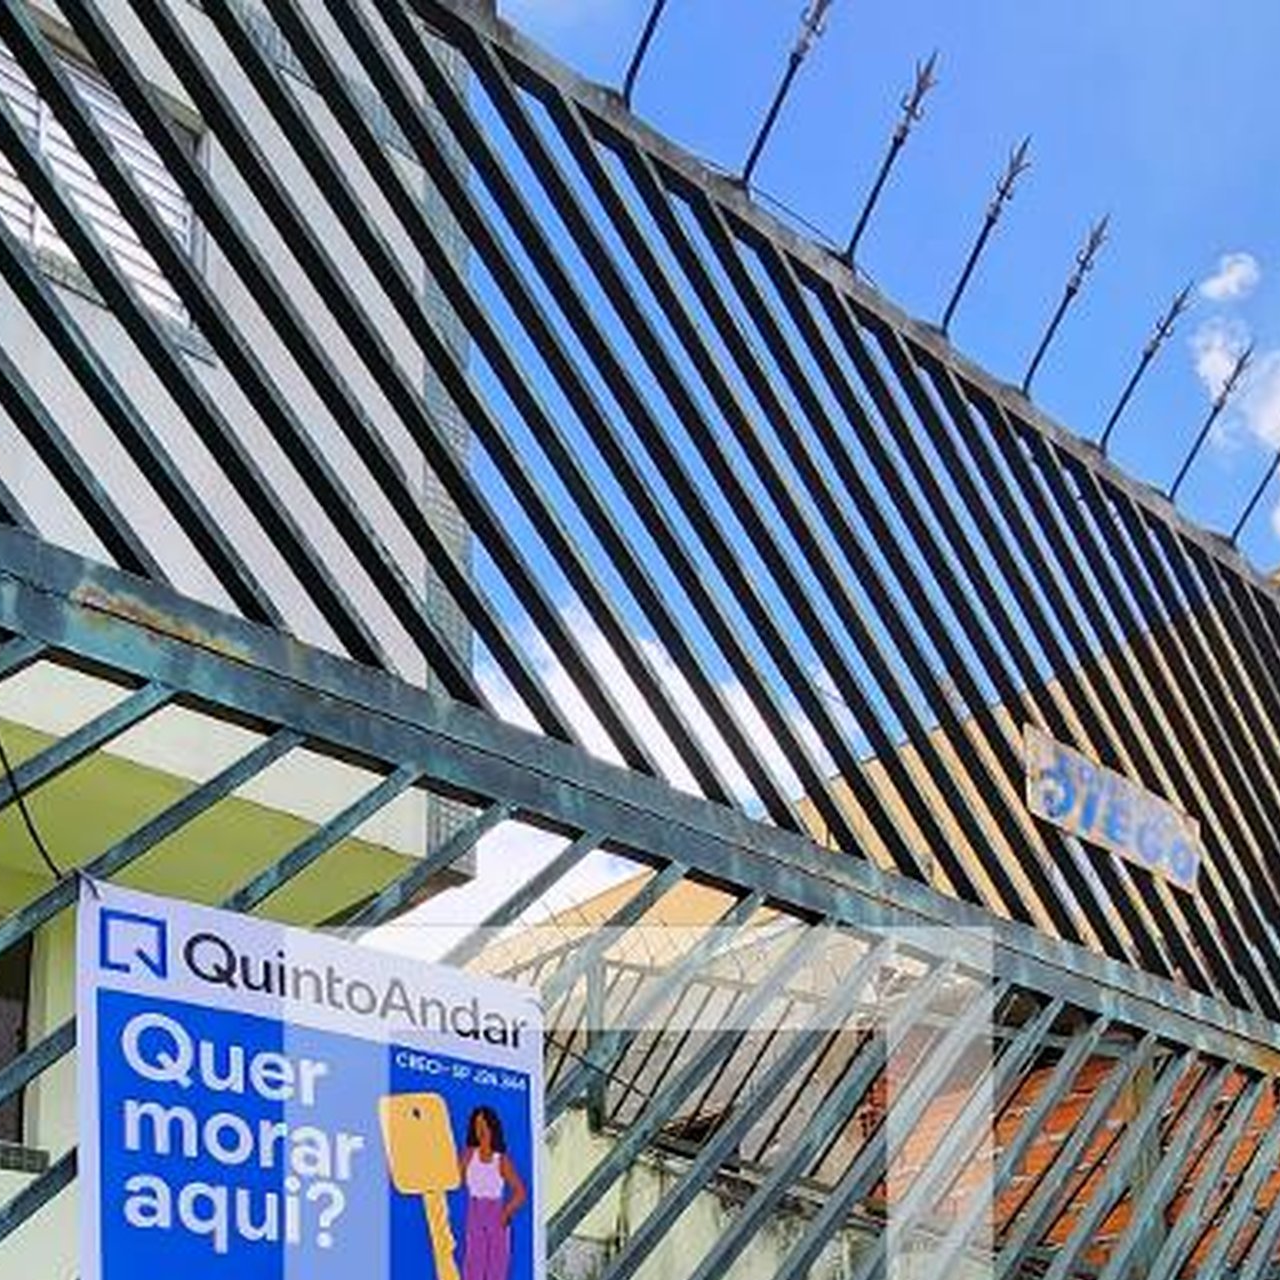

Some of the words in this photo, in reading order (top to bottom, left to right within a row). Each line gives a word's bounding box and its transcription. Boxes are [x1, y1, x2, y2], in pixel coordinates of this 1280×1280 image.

[183, 932, 528, 1048] QuintoAndar
[122, 1011, 329, 1107] Quer
[124, 1099, 363, 1182] morar
[123, 1174, 345, 1253] aqui?
